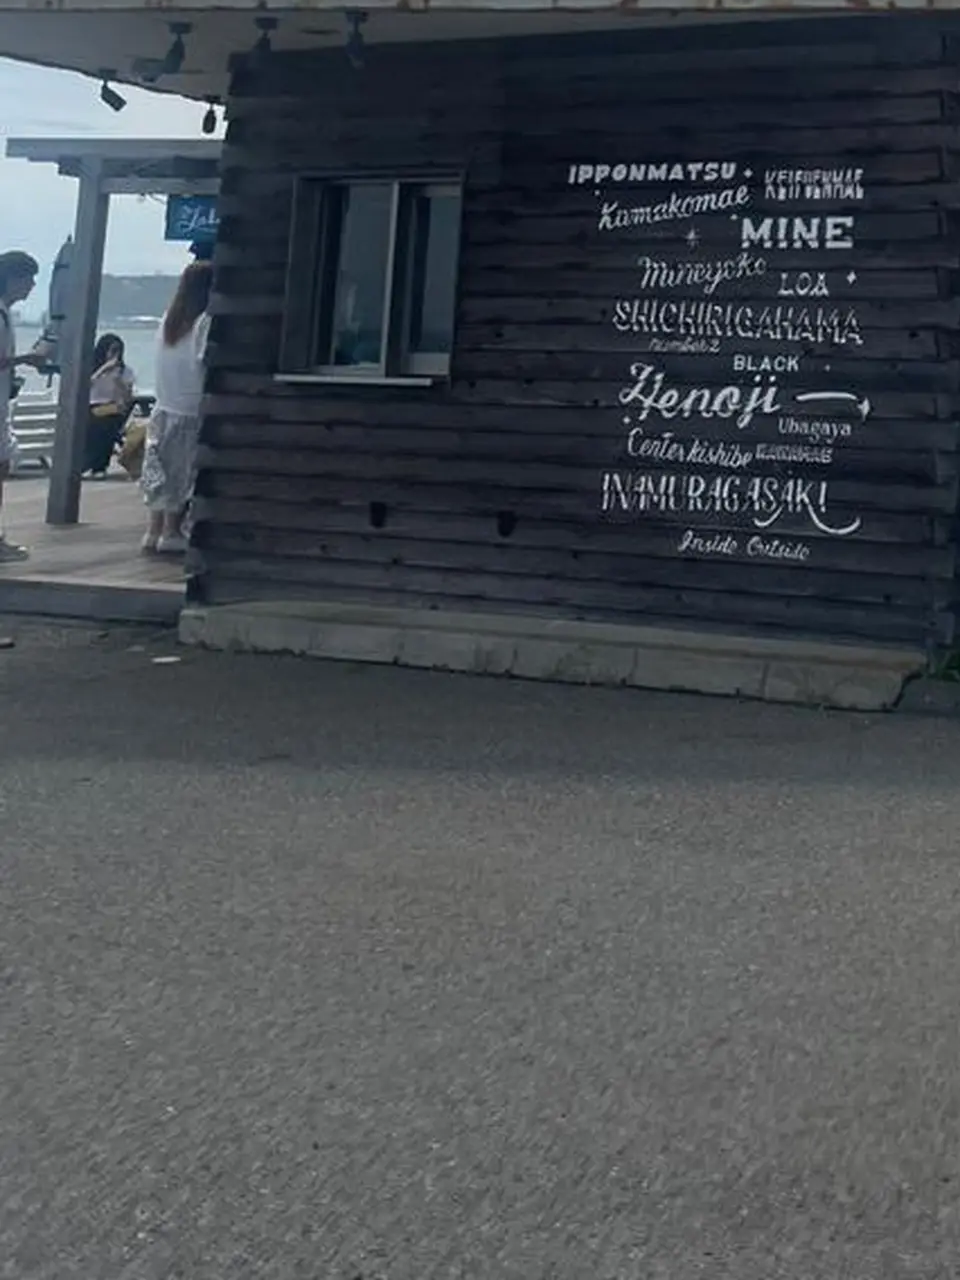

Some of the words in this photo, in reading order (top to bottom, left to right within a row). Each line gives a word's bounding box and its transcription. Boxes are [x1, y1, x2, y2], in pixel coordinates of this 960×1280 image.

[567, 162, 737, 185] IPPONMATSU
[741, 216, 854, 249] MINE
[733, 355, 800, 371] BLACK
